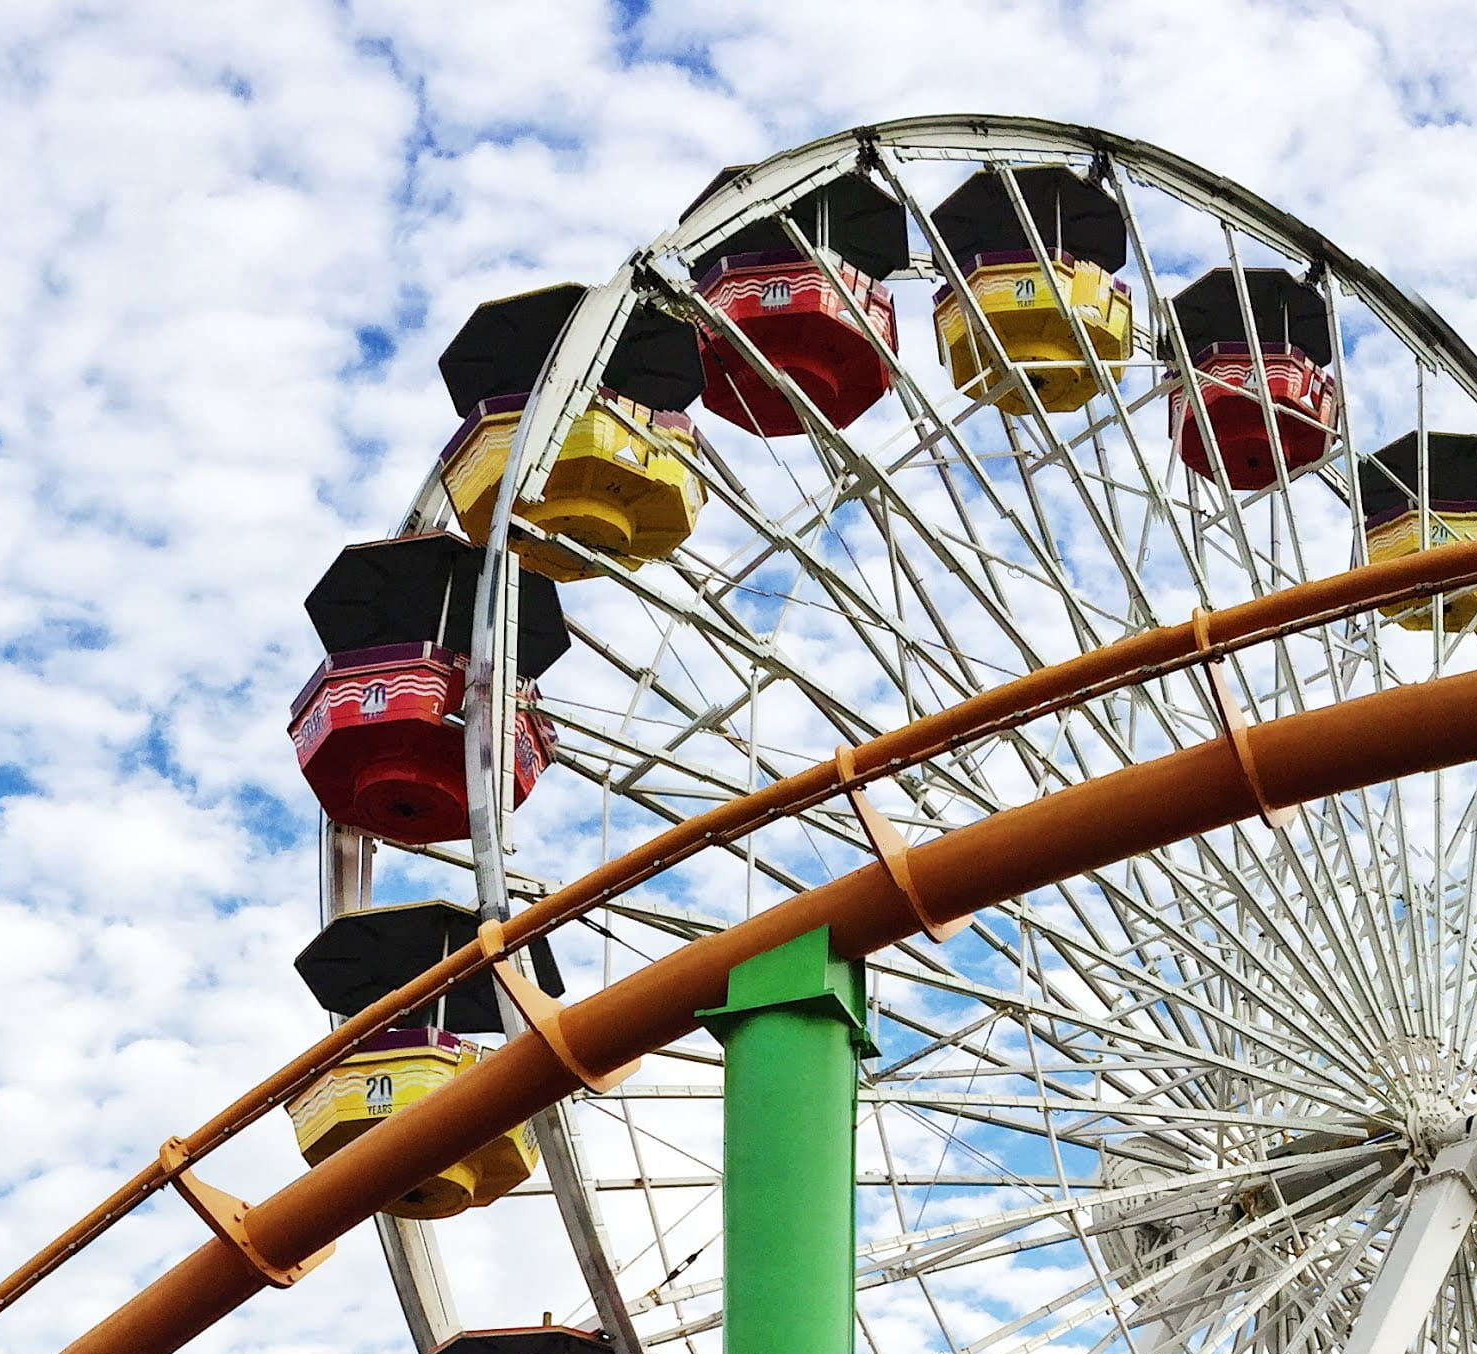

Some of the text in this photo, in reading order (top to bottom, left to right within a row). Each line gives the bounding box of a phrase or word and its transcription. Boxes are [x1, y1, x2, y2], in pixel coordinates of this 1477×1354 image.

[1016, 279, 1036, 299] 20
[431, 701, 440, 716] 1
[365, 1075, 393, 1103] 20
[367, 1103, 393, 1116] YEARS
